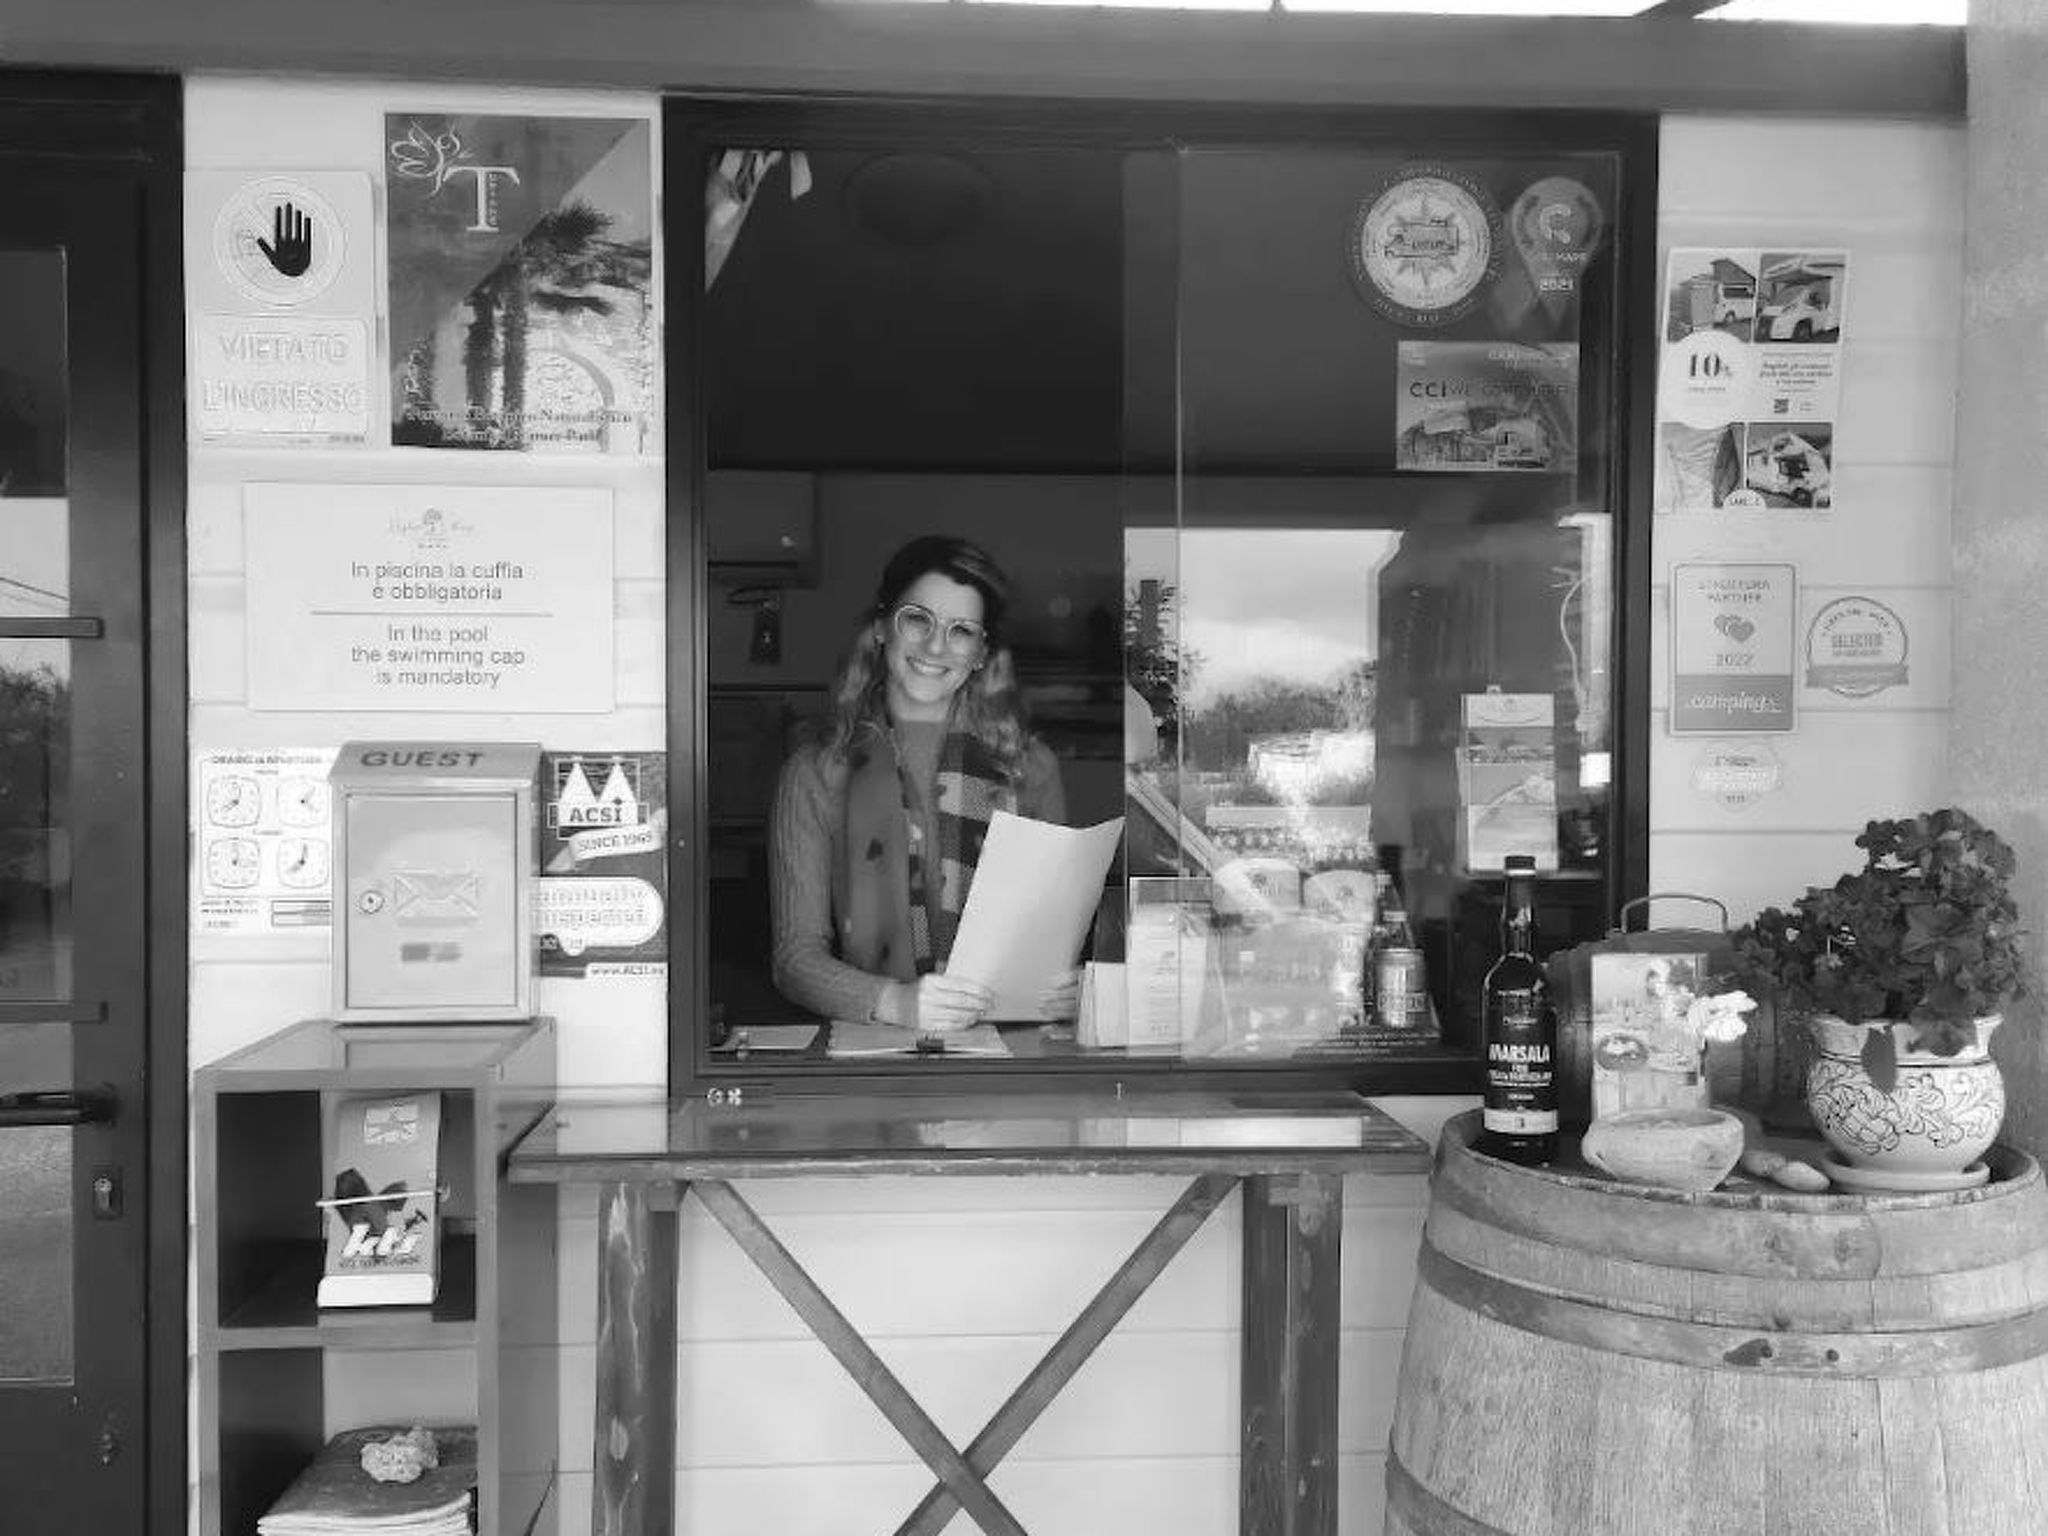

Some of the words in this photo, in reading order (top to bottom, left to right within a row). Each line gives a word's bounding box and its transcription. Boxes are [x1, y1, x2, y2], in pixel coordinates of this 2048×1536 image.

[219, 333, 350, 363] VIETATO
[351, 562, 369, 579] In
[375, 562, 443, 585] piscina
[449, 562, 465, 579] la
[472, 562, 523, 580] cuffia
[391, 584, 502, 604] obbligatoria
[388, 624, 404, 641] In
[412, 624, 442, 642] the
[449, 625, 488, 646] pool
[351, 646, 381, 663] the
[388, 648, 483, 667] swimming
[490, 651, 525, 668] cap
[376, 669, 391, 685] is
[399, 670, 501, 689] mandatory
[360, 751, 485, 767] GUEST
[577, 835, 619, 852] SINCE
[1488, 1043, 1550, 1063] MARSALA
